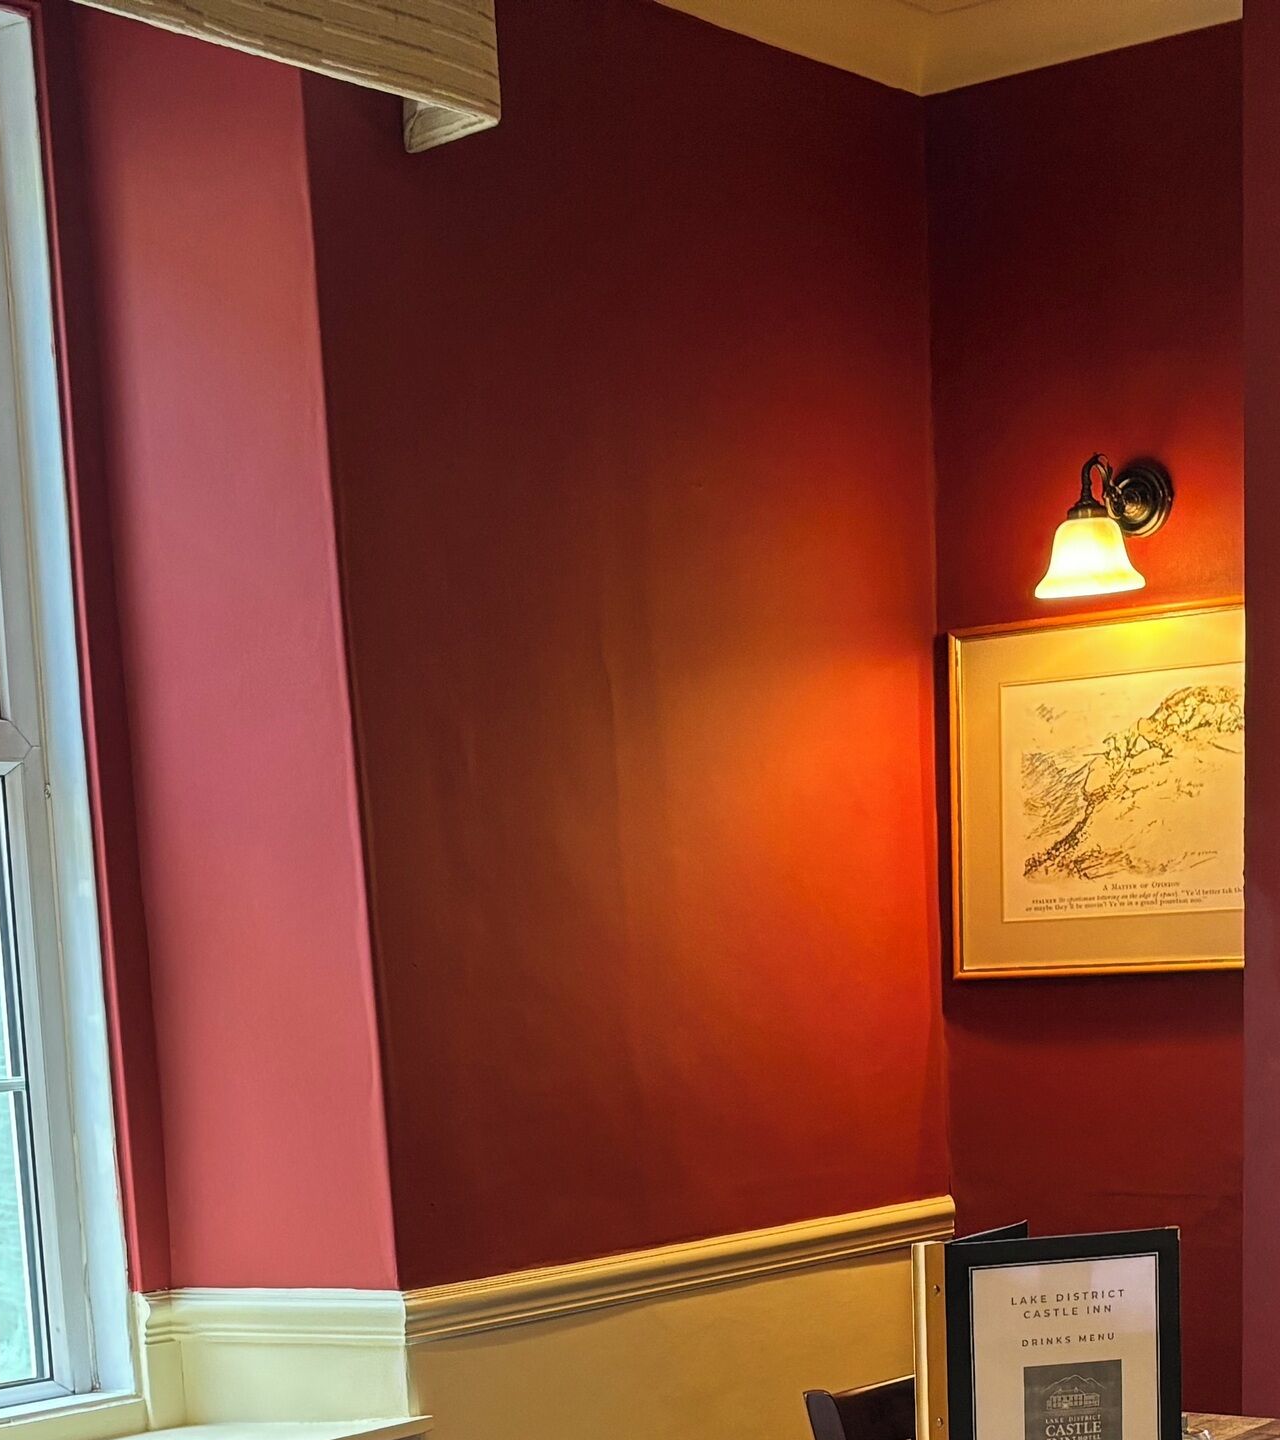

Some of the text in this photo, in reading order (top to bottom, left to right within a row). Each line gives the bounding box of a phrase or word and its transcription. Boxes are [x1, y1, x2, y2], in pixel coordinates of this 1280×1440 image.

[1011, 1288, 1125, 1306] LAKE DISTRICT
[1023, 1304, 1112, 1319] CASTLE INN
[1021, 1332, 1115, 1347] DRINKS MENU
[1068, 1414, 1101, 1422] DISTRICT
[1045, 1421, 1102, 1437] CASTLE
[1077, 1433, 1101, 1440] HOTEL
